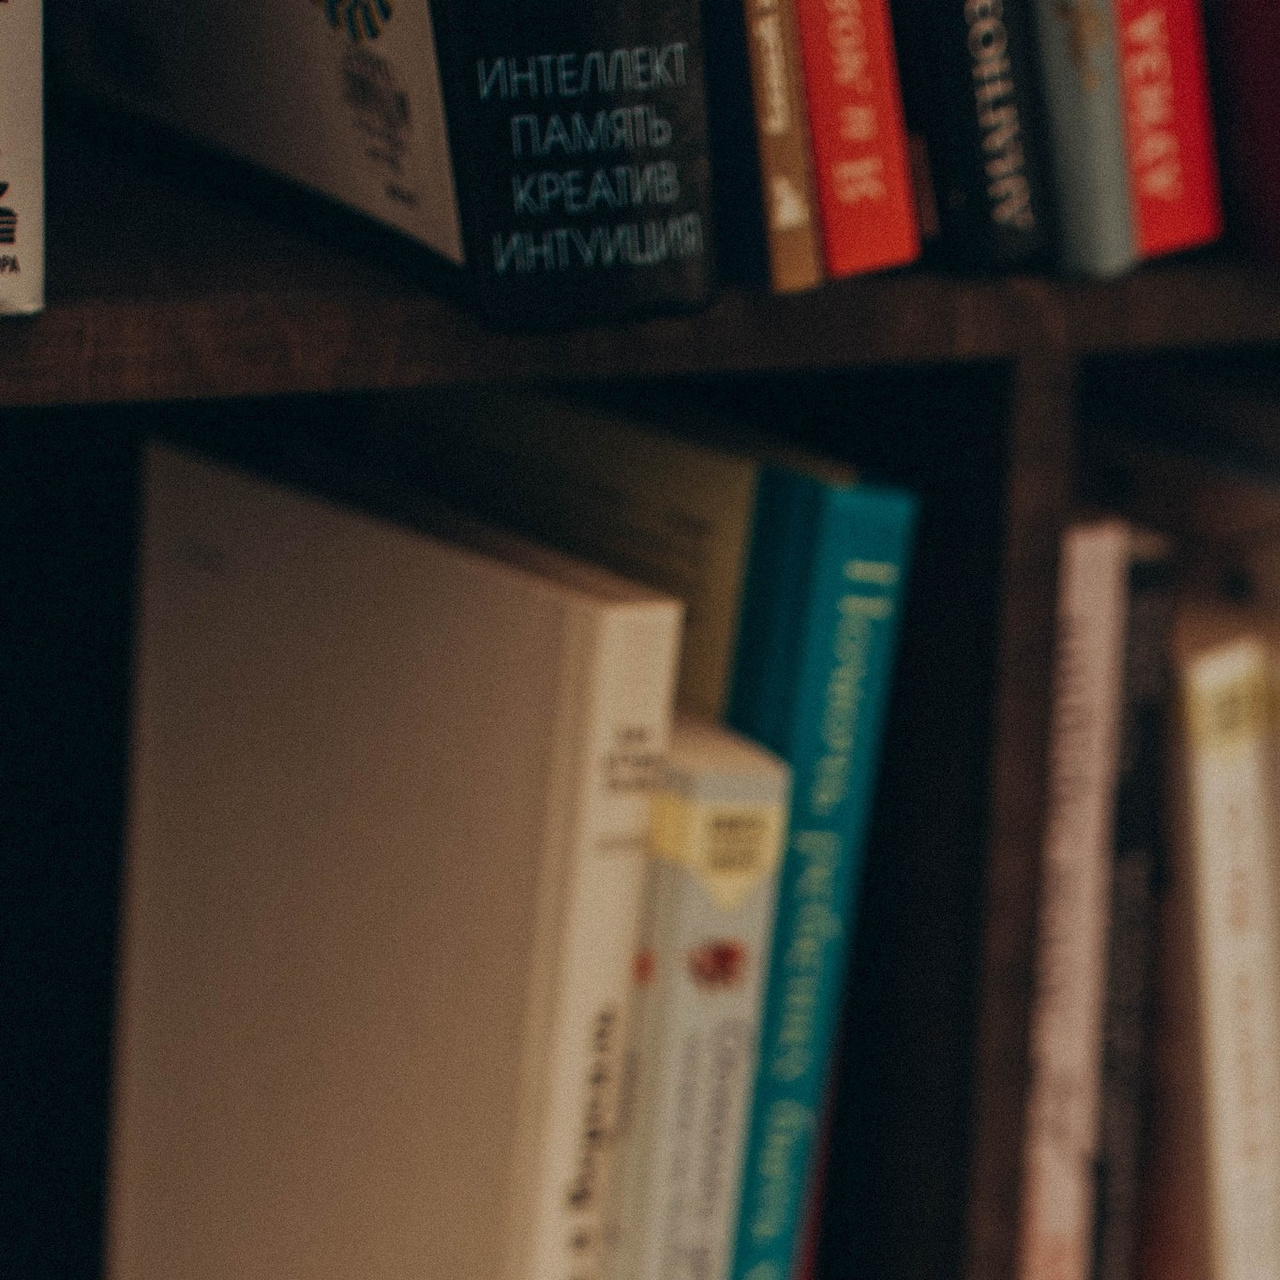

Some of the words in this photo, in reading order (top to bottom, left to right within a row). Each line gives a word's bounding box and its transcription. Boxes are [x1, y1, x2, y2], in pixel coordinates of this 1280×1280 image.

[477, 42, 688, 100] ИНТЕЛЛЕКТ
[511, 104, 672, 156] ПАМЯТЬ
[512, 160, 680, 215] КРЕАТИВ
[494, 212, 703, 274] ИНТУИЦИЯ
